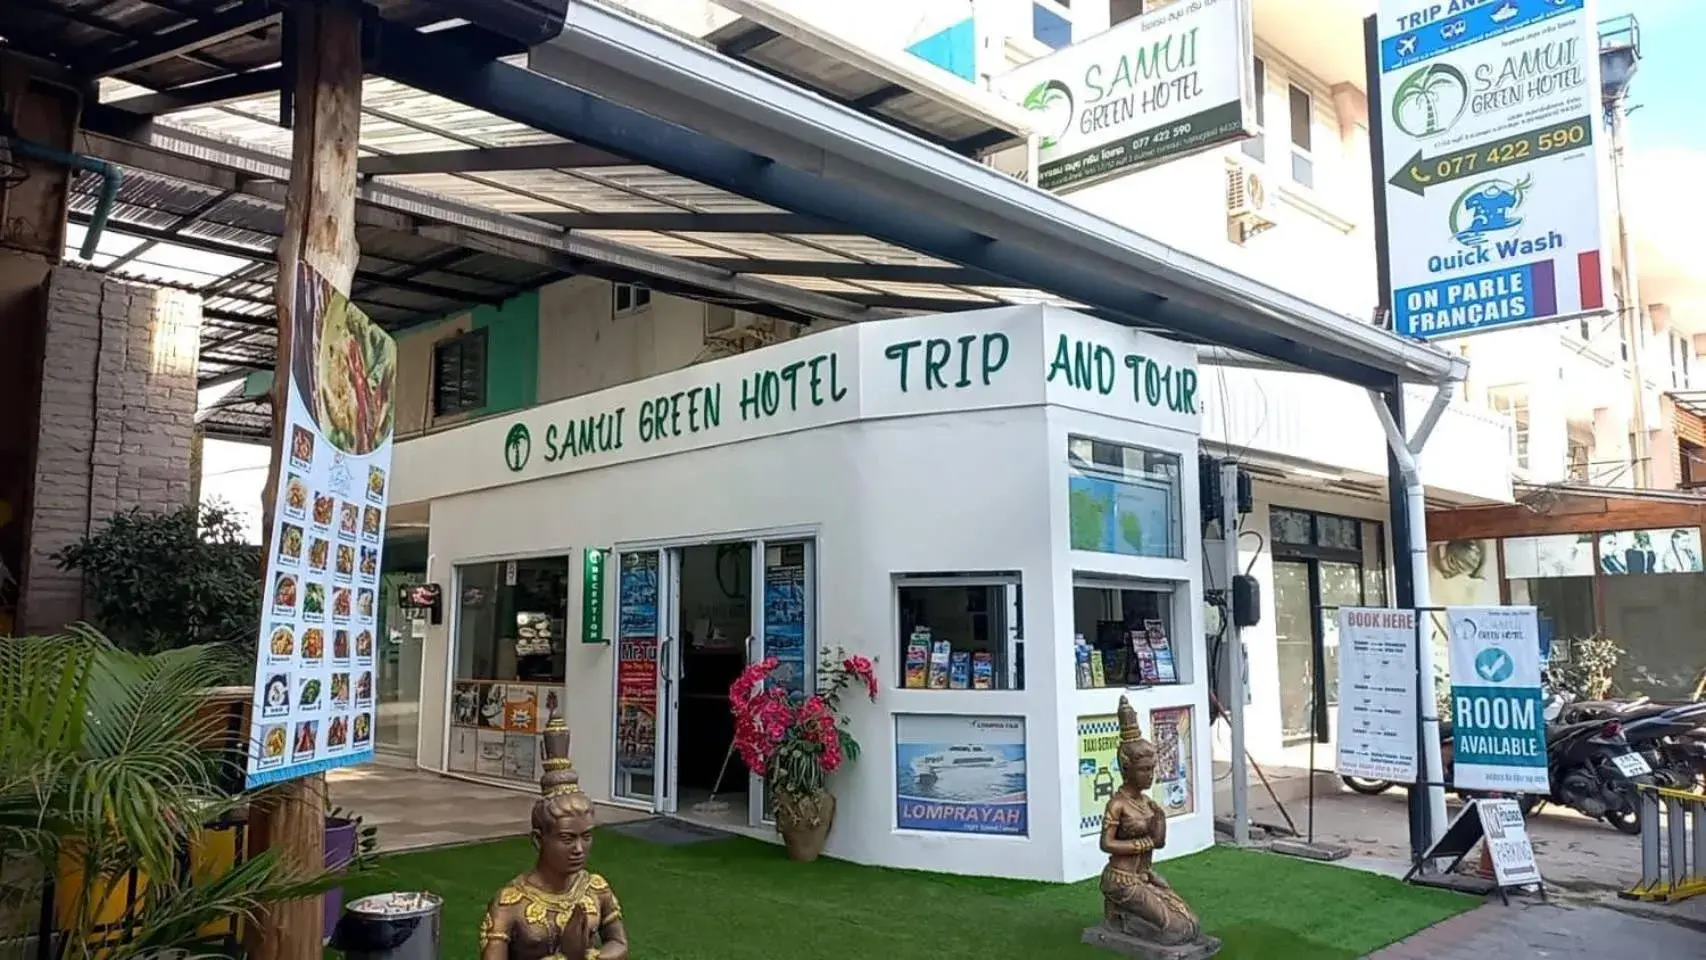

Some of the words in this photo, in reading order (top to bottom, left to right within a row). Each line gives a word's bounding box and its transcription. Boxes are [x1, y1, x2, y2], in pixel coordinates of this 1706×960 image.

[1397, 4, 1441, 31] TRIP
[1084, 27, 1199, 103] SAMUI
[1473, 37, 1580, 92] SAMUI
[1080, 93, 1134, 135] GREEN
[1142, 71, 1203, 114] HOTEL
[1471, 85, 1523, 115] GREEN
[1527, 66, 1584, 99] HOTEL
[1132, 136, 1150, 150] 077
[1153, 130, 1171, 144] 422
[1173, 123, 1191, 138] 590
[1437, 153, 1478, 177] 077
[1486, 140, 1530, 163] 422
[1538, 125, 1585, 150] 590
[1428, 248, 1490, 273] Quick
[1496, 231, 1563, 260] Wash
[1407, 289, 1439, 312] ON
[1447, 272, 1524, 304] PARLE
[1408, 296, 1527, 334] FRANÇAIS
[544, 407, 626, 463] SAMUI
[639, 382, 721, 443] GREEN
[739, 352, 848, 422] HOTEL
[884, 332, 1009, 393] TRIP
[1047, 334, 1115, 395] AND
[1125, 353, 1198, 415] TOUR
[590, 565, 599, 639] RECEPTION
[1348, 611, 1380, 628] BOOK
[1382, 613, 1414, 630] HERE
[1456, 696, 1536, 731] ROOM
[1083, 738, 1098, 752] TAXI
[1459, 735, 1538, 757] AVAILABLE
[903, 803, 1020, 825] LOMPRAYAH
